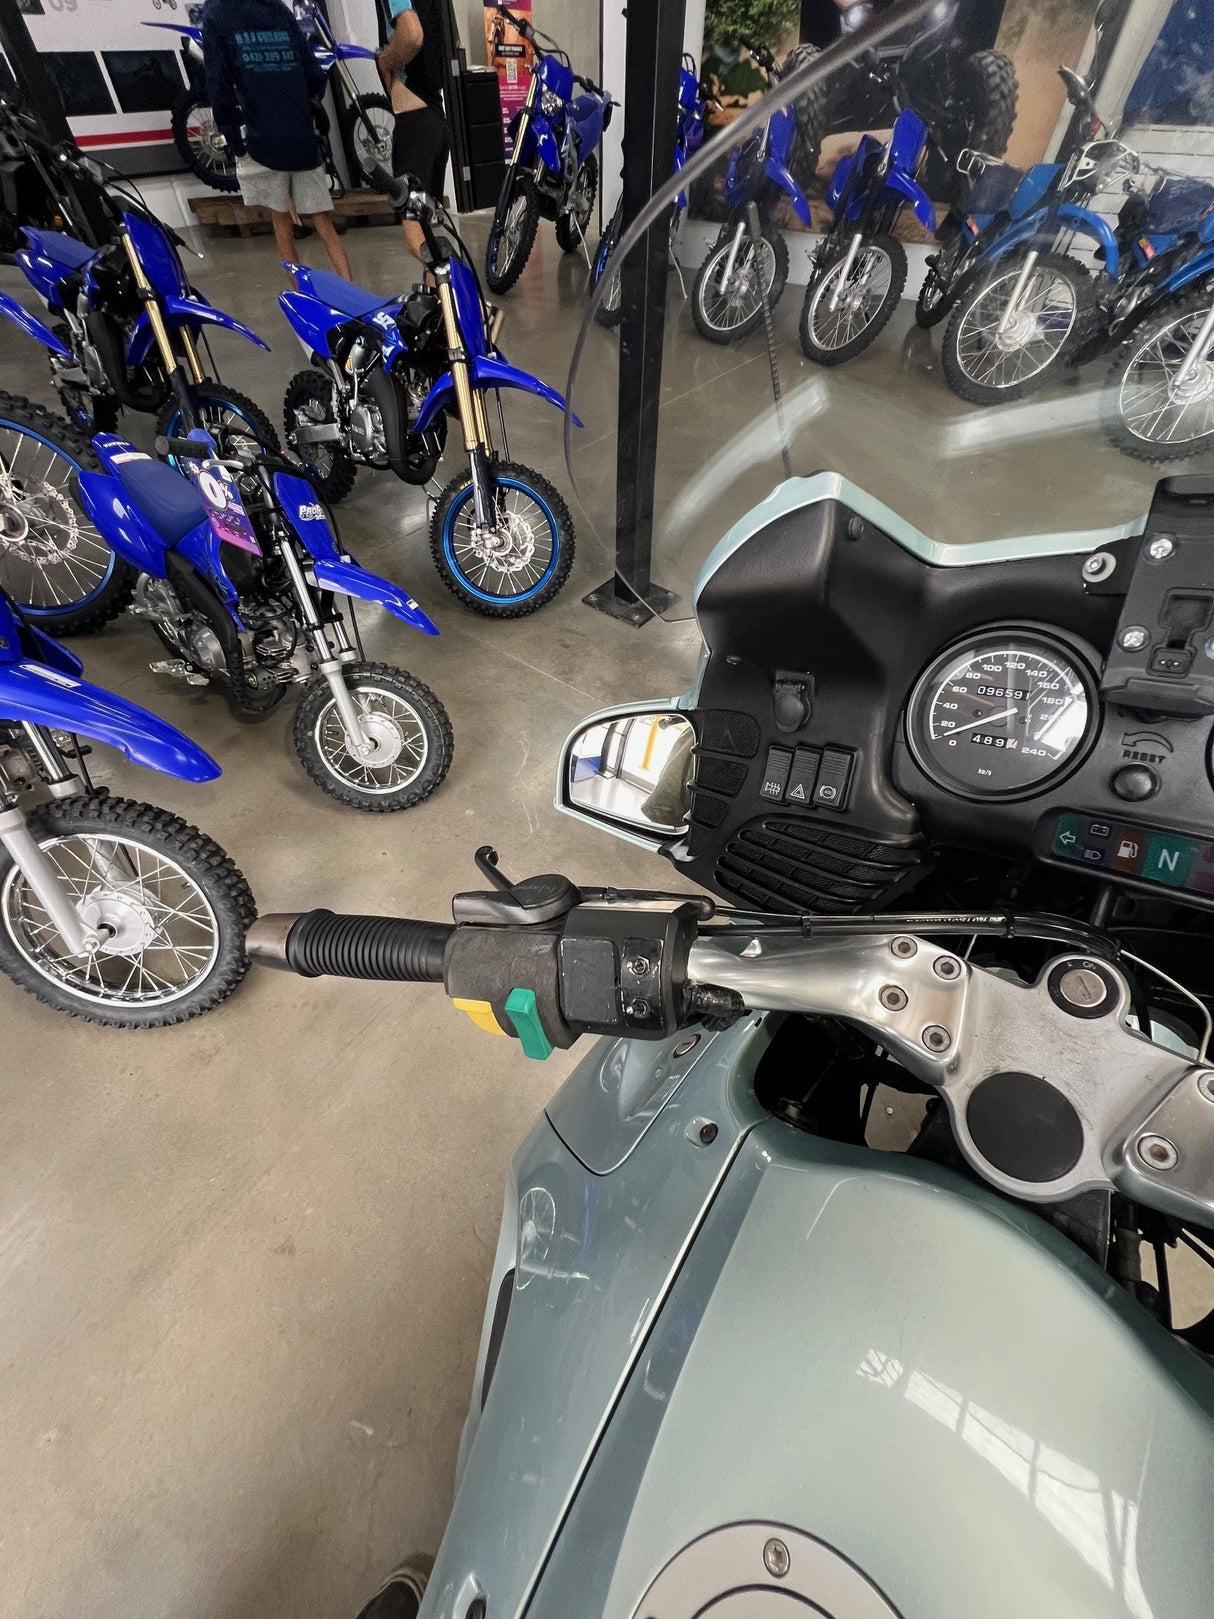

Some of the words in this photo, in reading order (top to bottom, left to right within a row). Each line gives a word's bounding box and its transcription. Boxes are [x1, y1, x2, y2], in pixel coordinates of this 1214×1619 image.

[982, 664, 1003, 672] 100
[1004, 661, 1026, 670] 120
[965, 672, 981, 680] 80
[1025, 669, 1048, 678] 140
[1036, 681, 1060, 690] 160
[1041, 696, 1064, 705] 180
[942, 702, 959, 710] 40
[940, 720, 956, 728] 20
[948, 739, 957, 747] 0
[1021, 746, 1047, 757] 240
[1122, 750, 1166, 764] RESET
[1157, 848, 1180, 872] N
